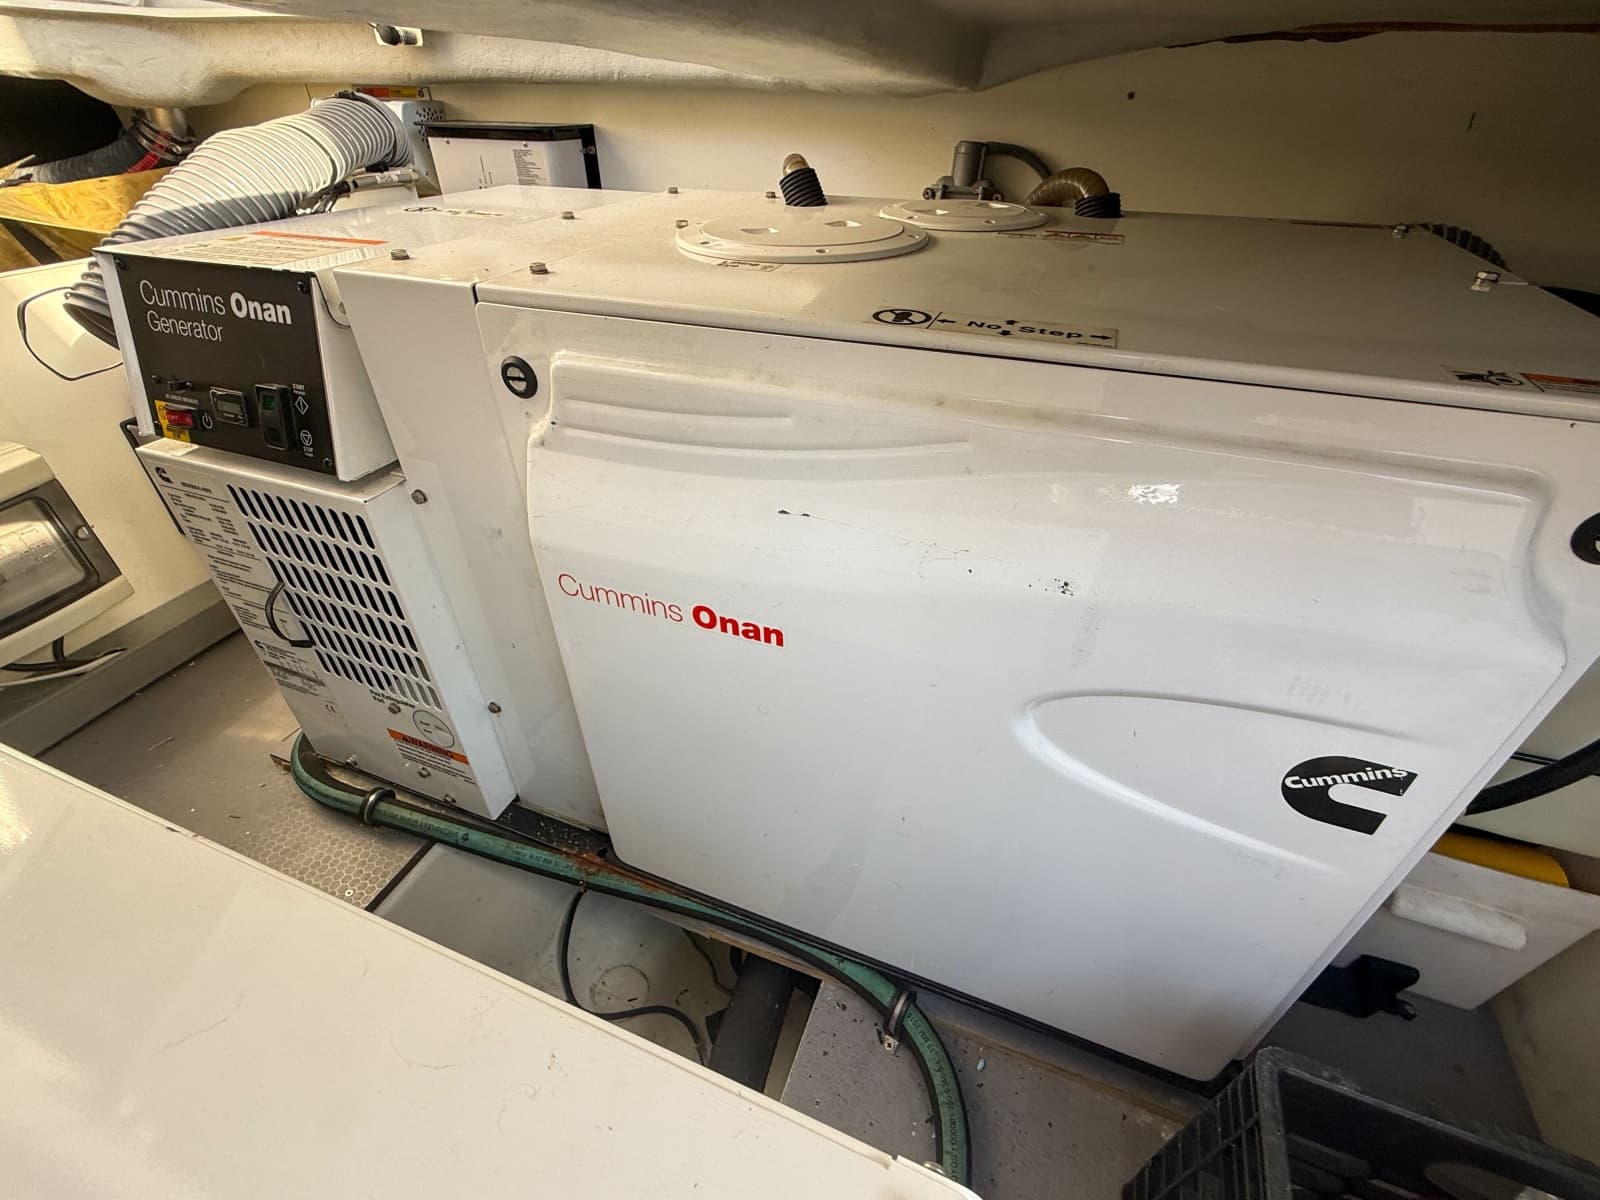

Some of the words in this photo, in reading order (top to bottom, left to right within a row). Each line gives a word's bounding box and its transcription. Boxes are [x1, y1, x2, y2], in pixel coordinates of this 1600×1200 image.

[139, 279, 225, 316] Cummins
[230, 291, 292, 326] Onan
[147, 310, 223, 342] Generator
[967, 320, 1002, 330] No
[1018, 326, 1083, 339] Step
[558, 573, 684, 623] Cummins
[692, 605, 784, 648] Onan
[1284, 767, 1408, 789] Cummins
